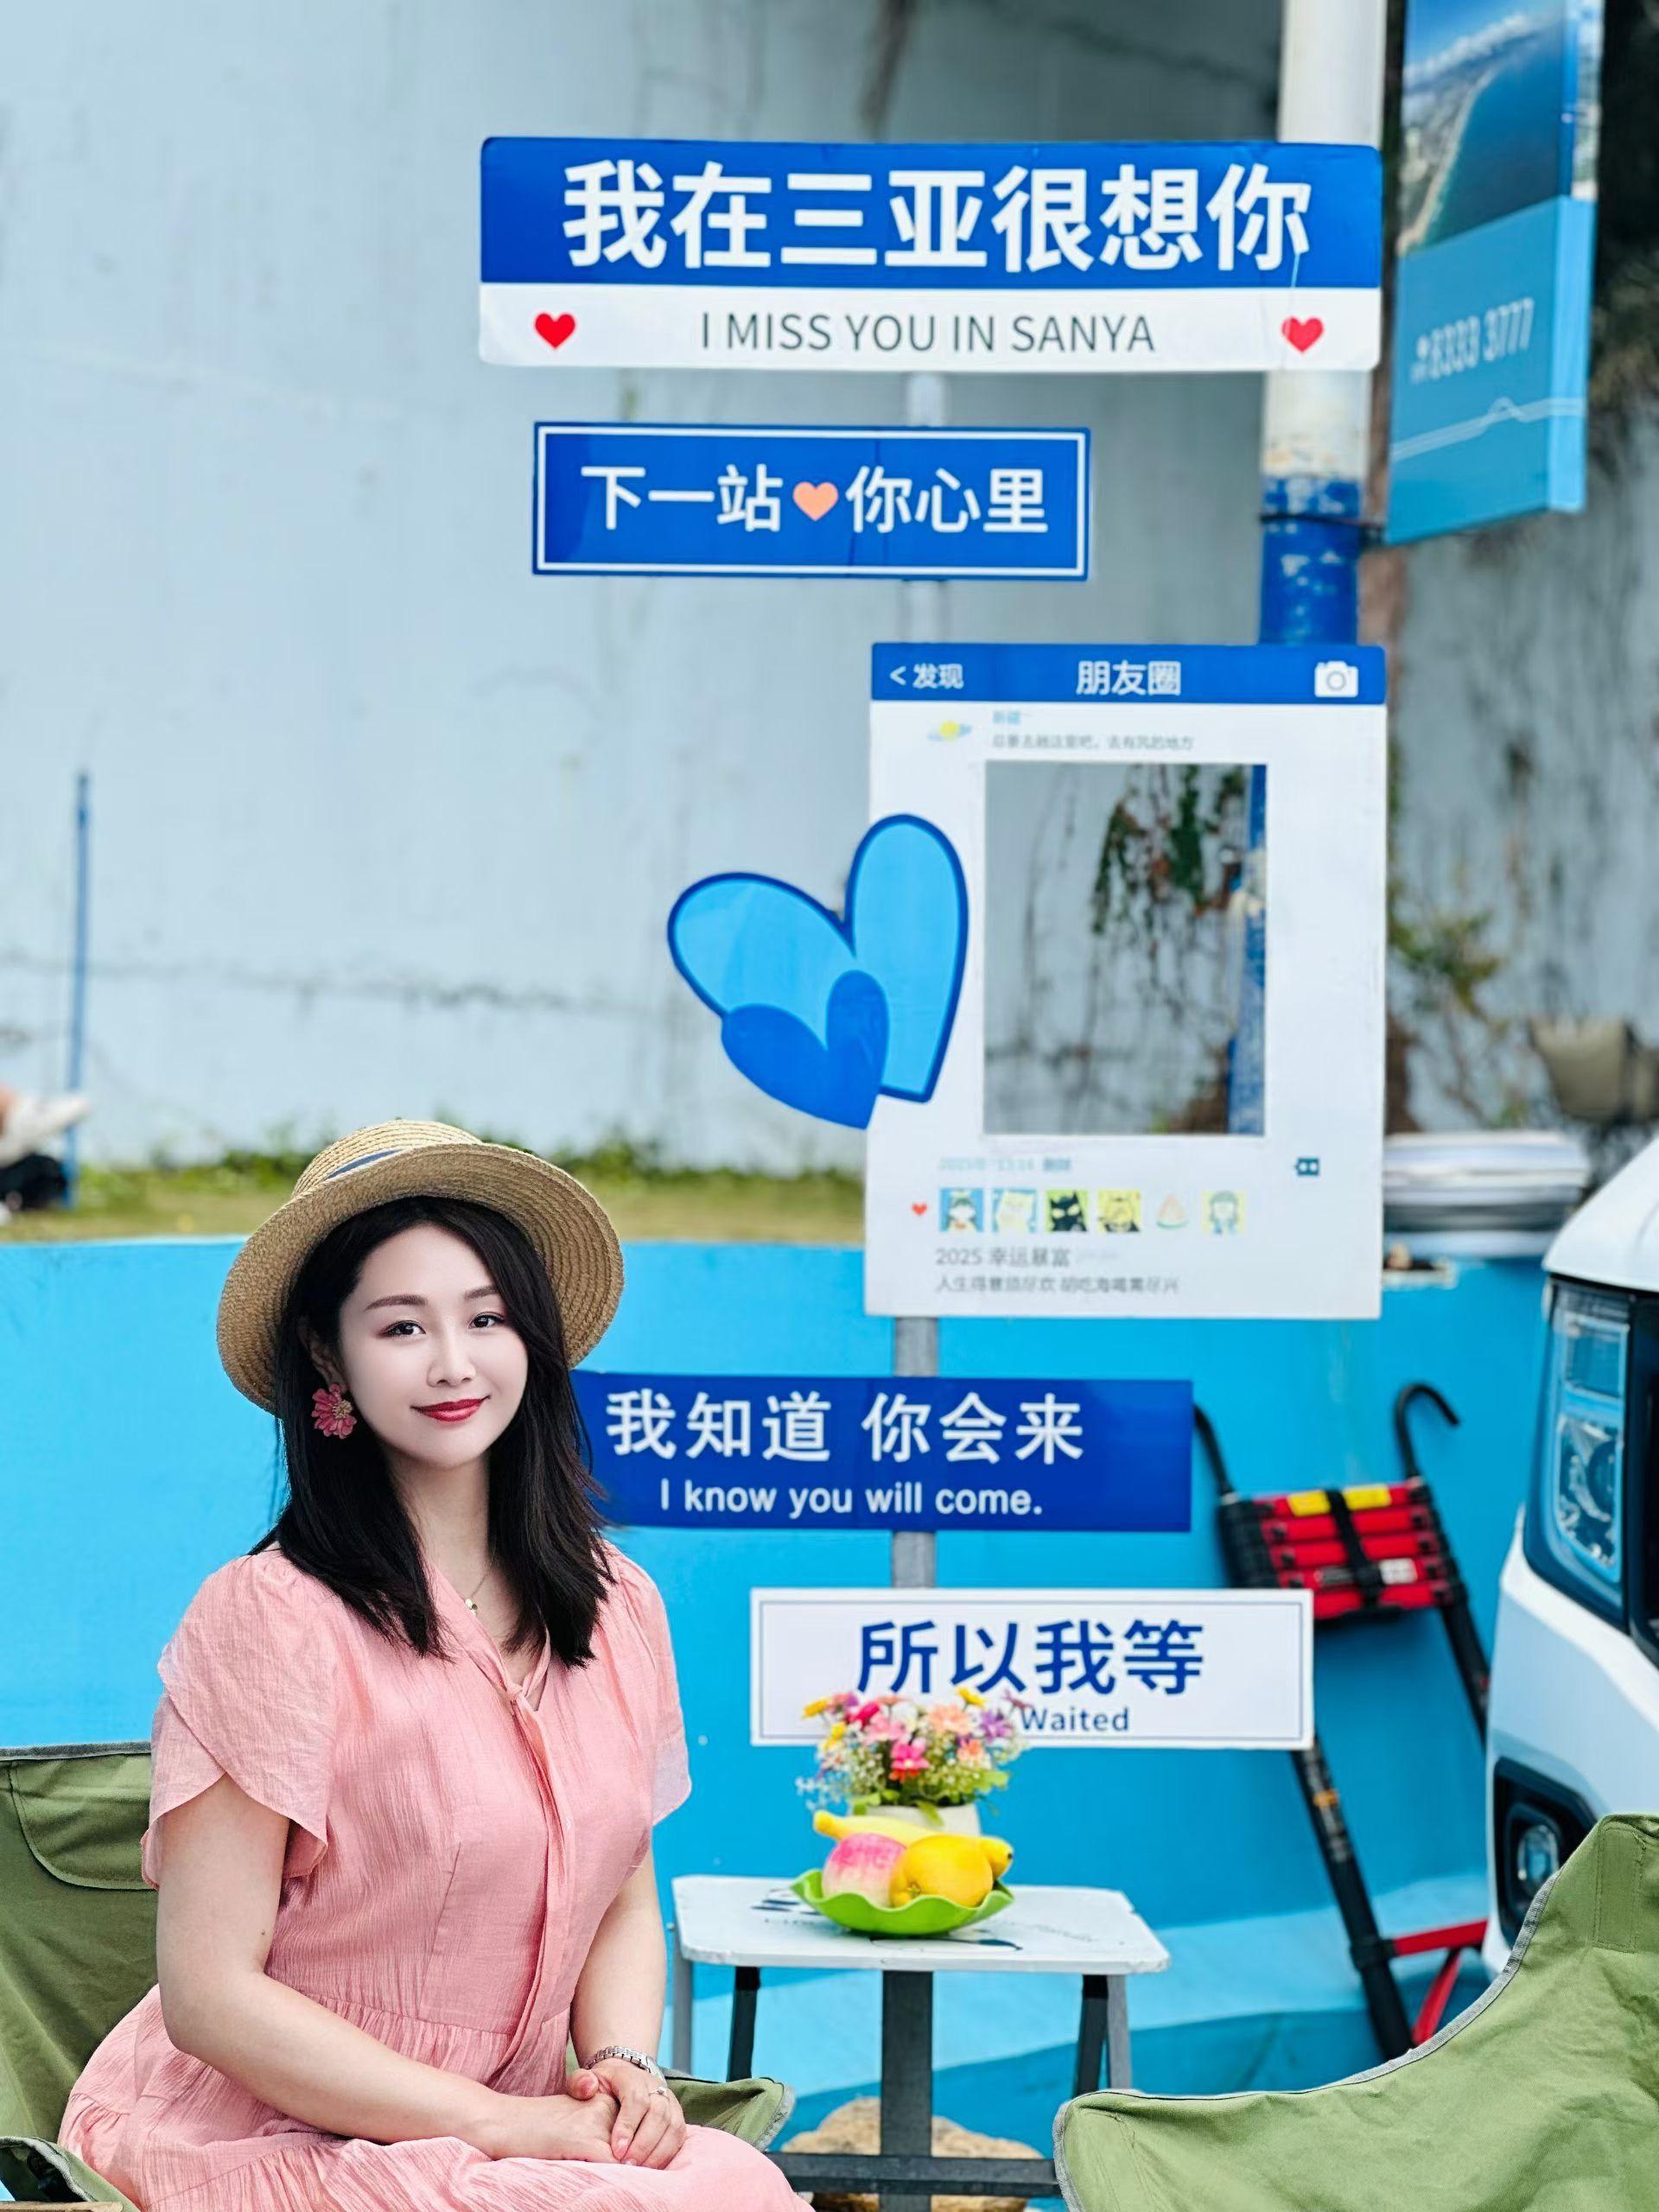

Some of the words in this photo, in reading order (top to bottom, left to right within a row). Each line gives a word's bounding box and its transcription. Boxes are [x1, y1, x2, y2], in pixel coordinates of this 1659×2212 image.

[563, 159, 1312, 273] 我在三亚很想你
[702, 312, 709, 349] I
[727, 313, 832, 351] MISS
[845, 315, 936, 352] YOU
[953, 315, 995, 352] IN
[1011, 315, 1156, 353] SANYA
[581, 463, 784, 532] 下一站
[845, 465, 1049, 533] 你心里
[912, 663, 963, 690] 发现
[1076, 659, 1181, 696] 朋友圈
[936, 1247, 983, 1267] 2025
[606, 1388, 832, 1462] 我知道
[861, 1391, 1084, 1465] 你会来
[661, 1478, 669, 1510] I
[684, 1479, 777, 1512] know
[788, 1487, 853, 1520] you
[865, 1481, 922, 1514] will
[935, 1488, 1043, 1516] come.
[857, 1618, 1205, 1695] 所以我等
[1020, 1705, 1130, 1732] Waited
